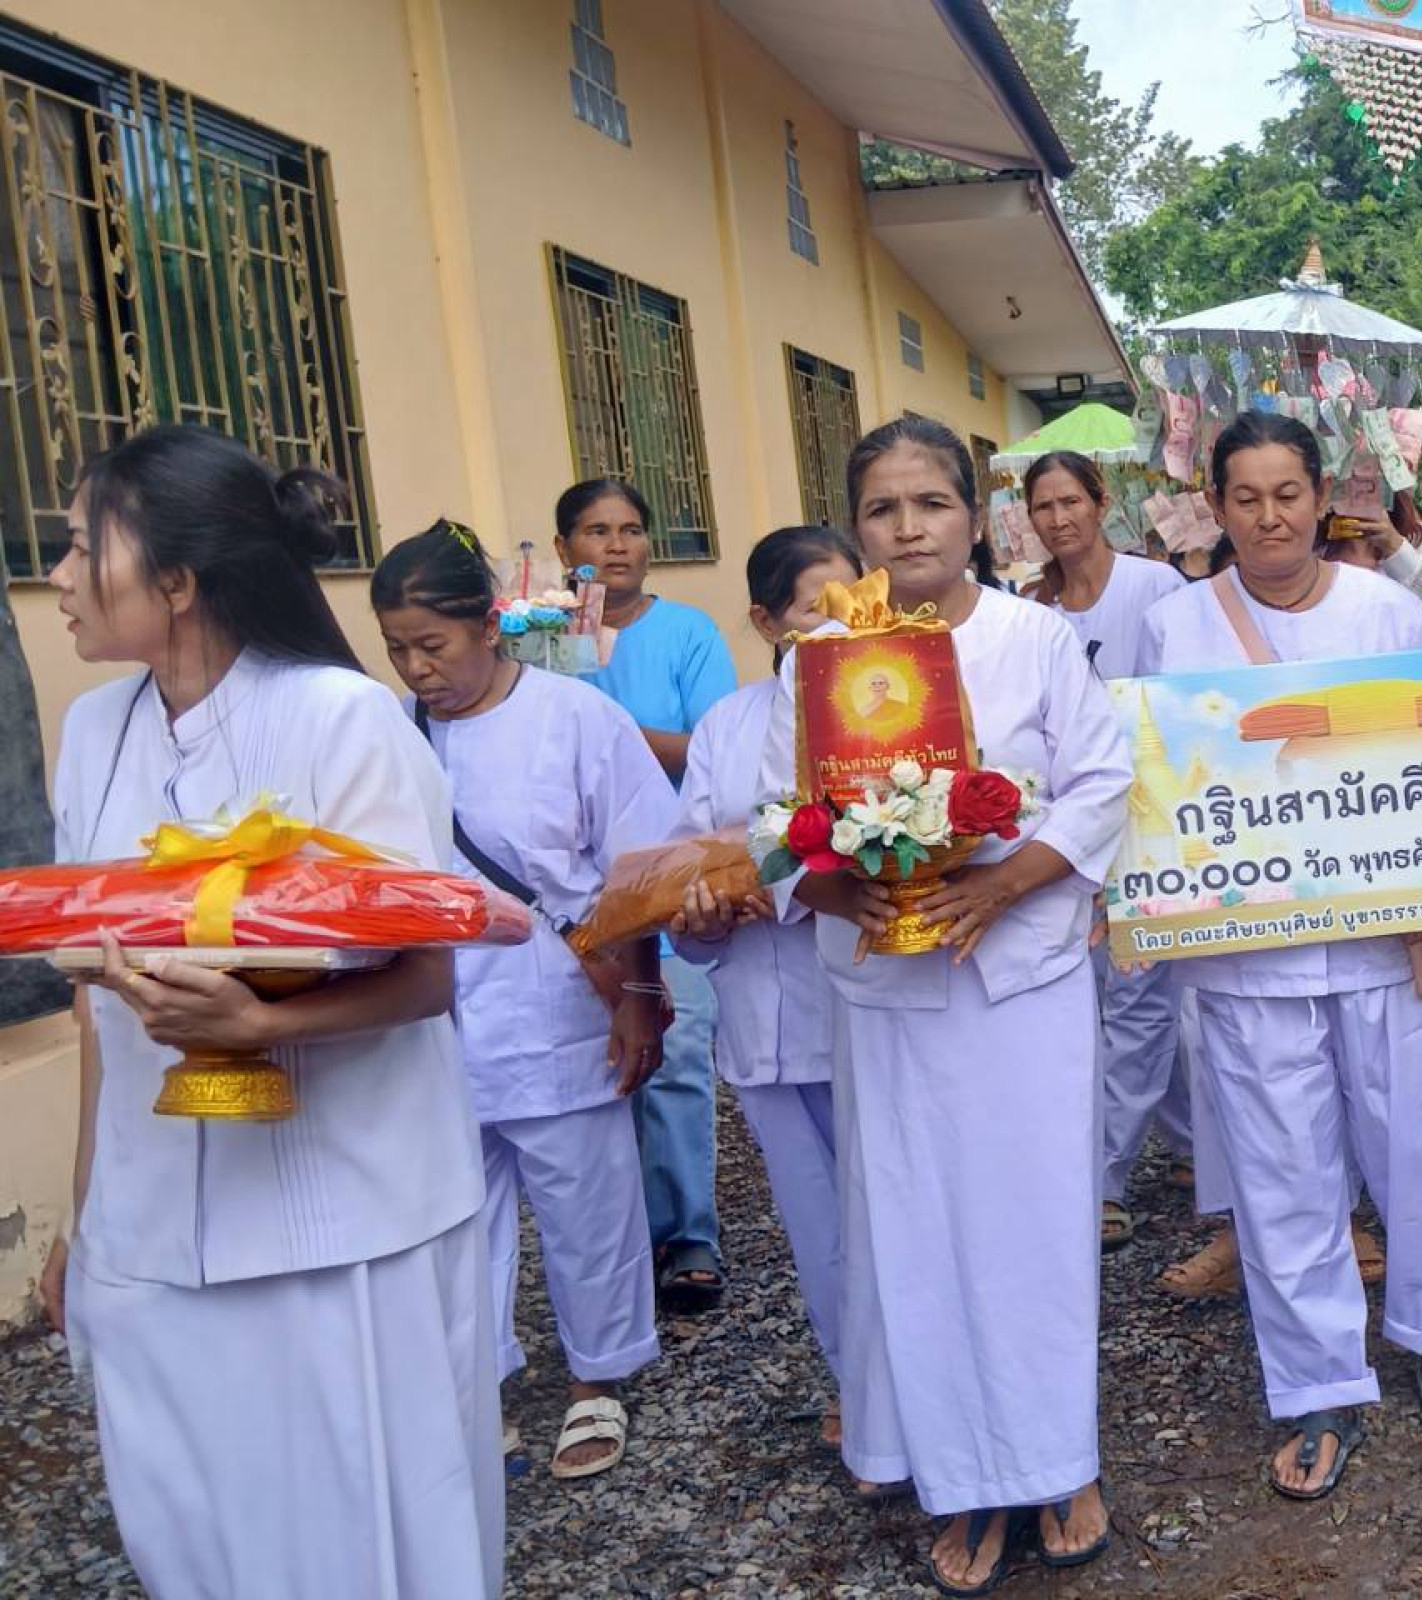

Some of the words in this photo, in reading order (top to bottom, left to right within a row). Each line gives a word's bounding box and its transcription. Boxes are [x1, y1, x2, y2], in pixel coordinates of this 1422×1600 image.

[1123, 856, 1292, 899] ๓๐,๐๐๐
[1304, 848, 1341, 878] วัด
[1134, 928, 1172, 949] โดย
